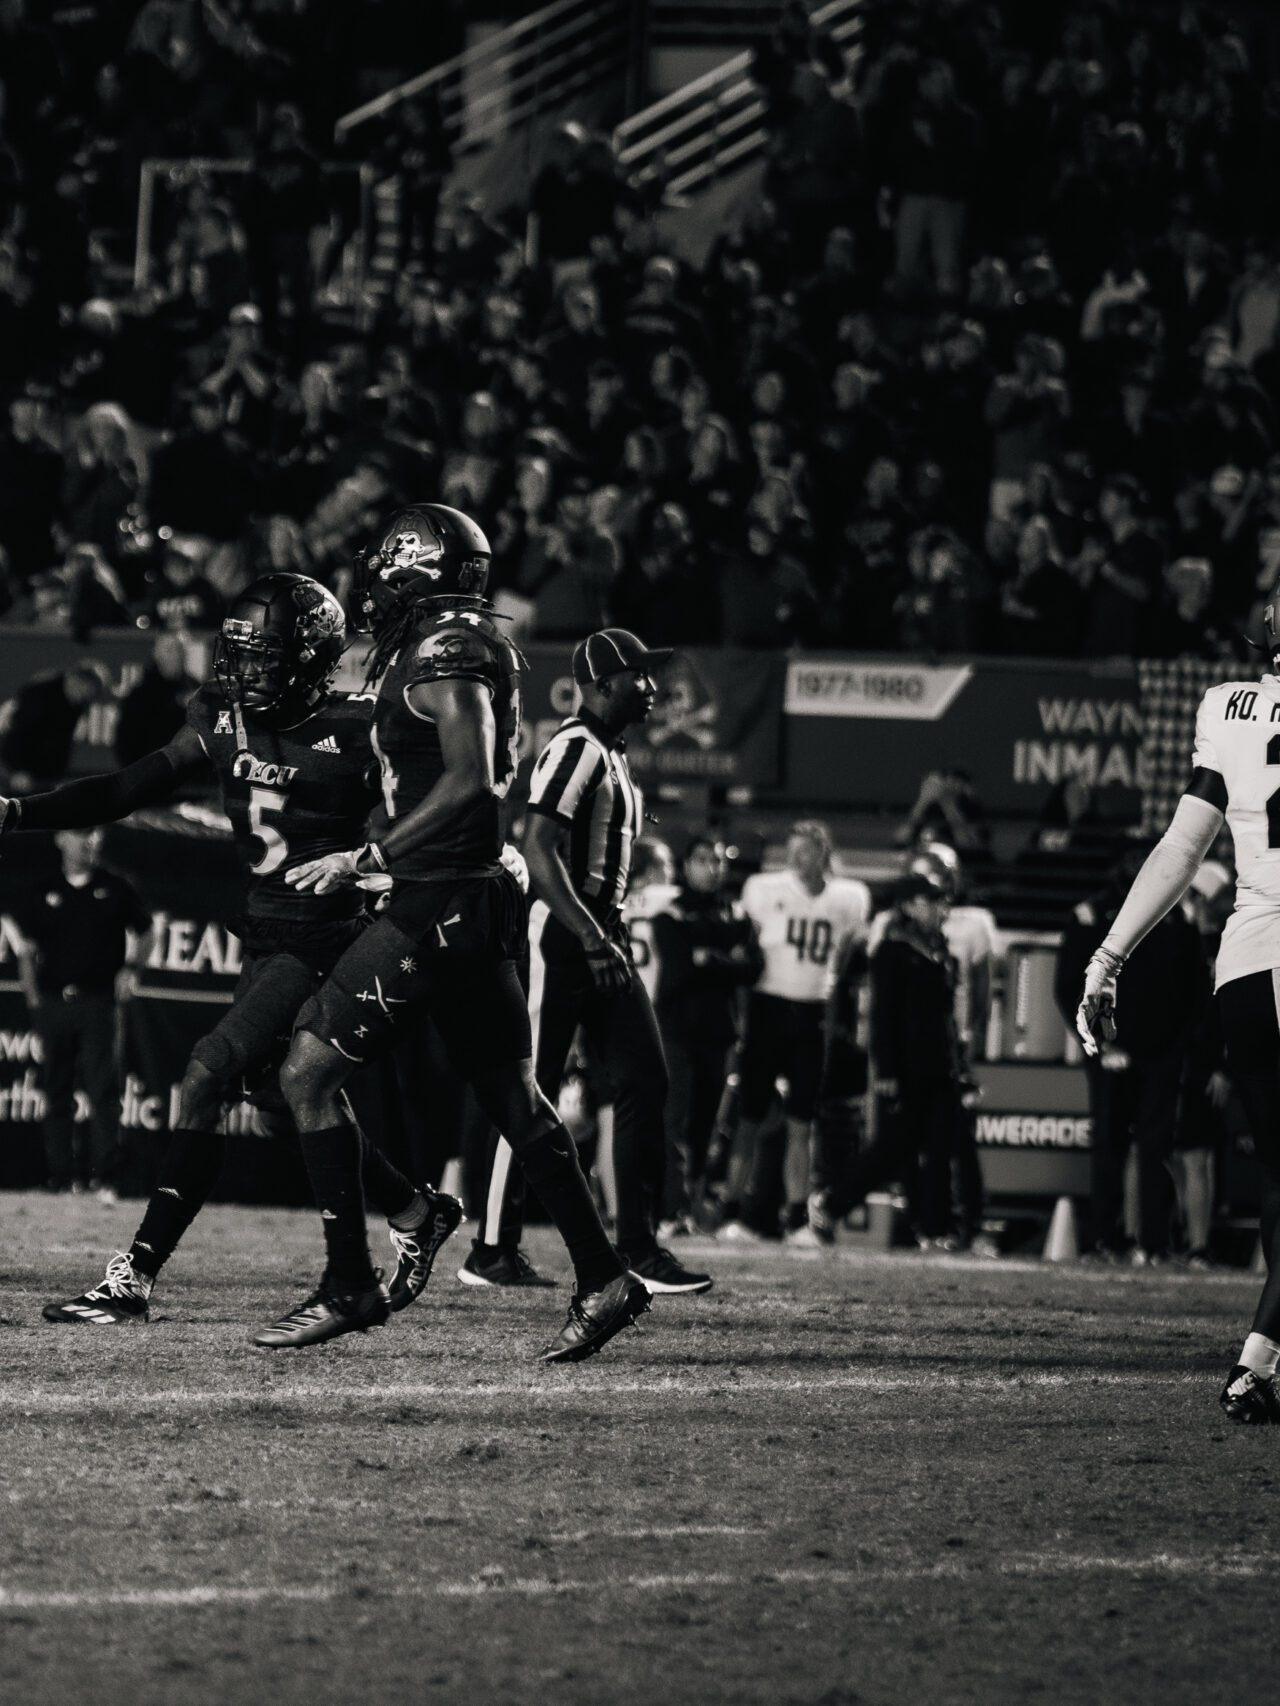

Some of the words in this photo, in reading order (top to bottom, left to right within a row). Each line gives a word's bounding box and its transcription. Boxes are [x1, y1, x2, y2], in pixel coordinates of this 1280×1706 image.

[1036, 697, 1144, 735] WAYN
[245, 761, 300, 787] ECU
[247, 786, 290, 877] 5
[124, 911, 244, 976] HEAL
[786, 917, 832, 964] 40
